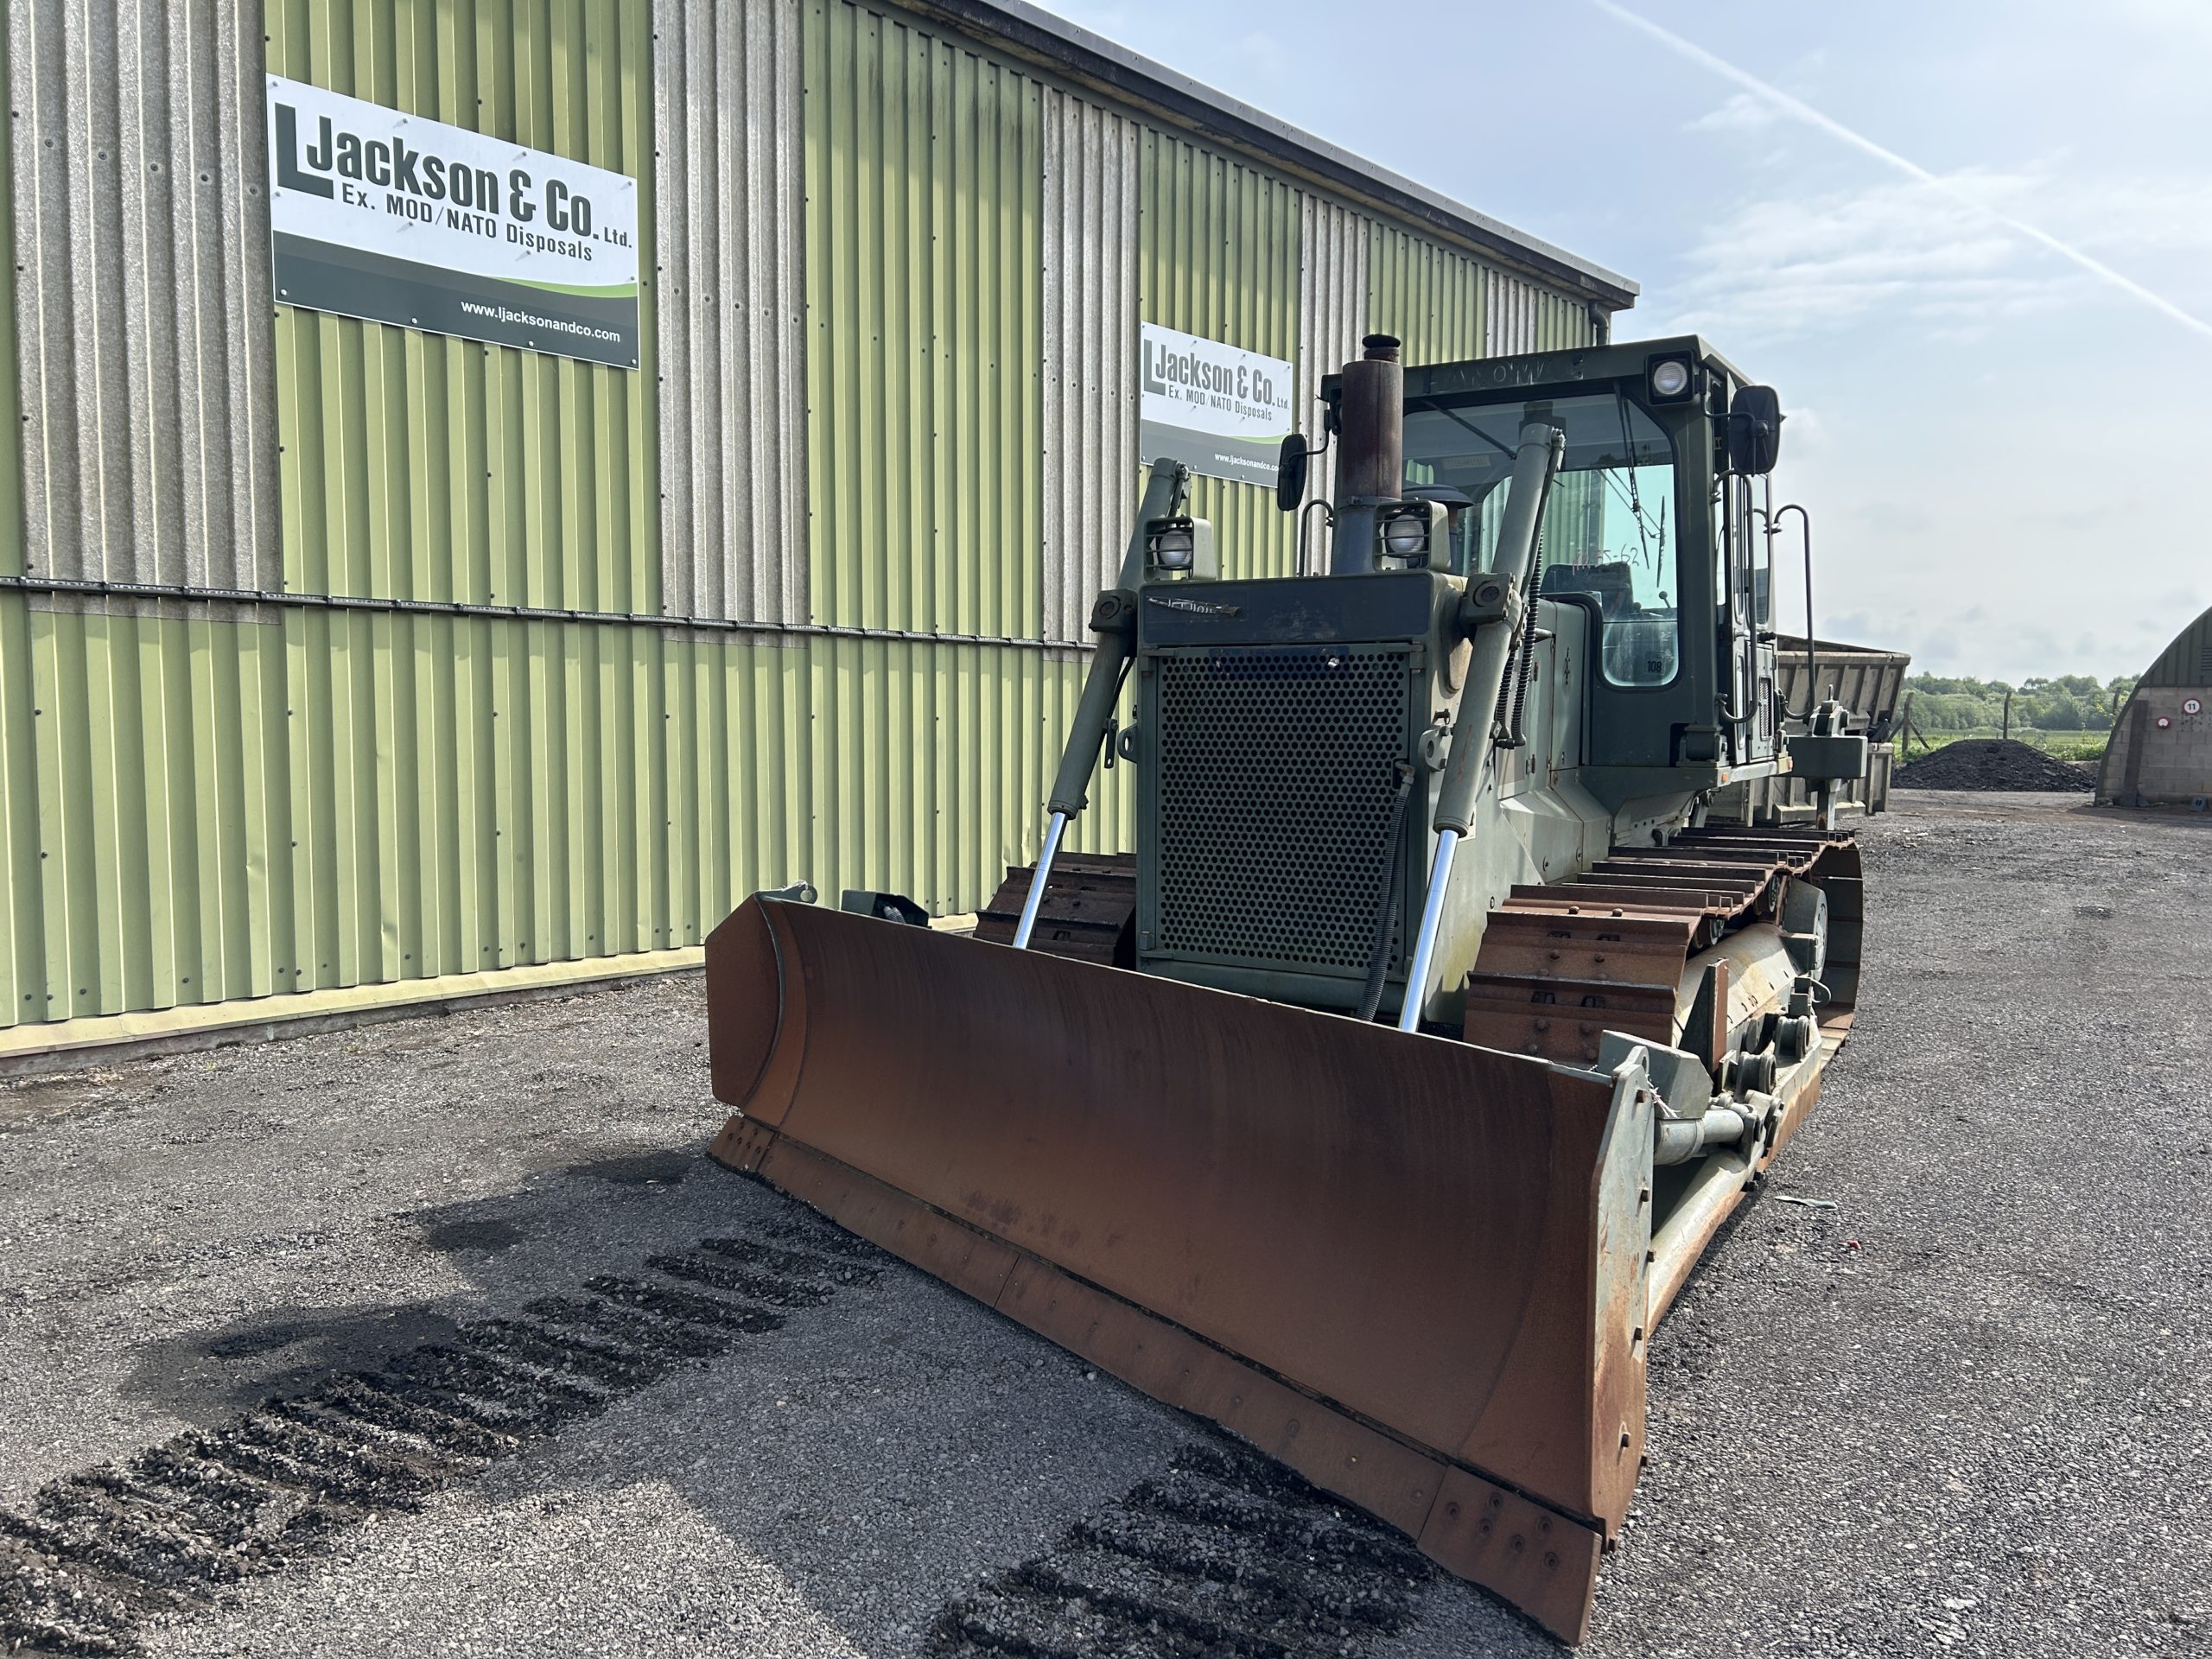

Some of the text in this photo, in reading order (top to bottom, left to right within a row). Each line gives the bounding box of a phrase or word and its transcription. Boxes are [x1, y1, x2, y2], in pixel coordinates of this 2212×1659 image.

[342, 182, 375, 209] Ex.
[507, 224, 593, 261] Disposals
[510, 169, 536, 222] &
[545, 179, 599, 240] Co.
[605, 226, 632, 249] Ltd.
[461, 301, 621, 343] www.ljacksonandco.com
[1168, 385, 1182, 401] Ex.
[1235, 400, 1272, 422] Disposals
[1237, 365, 1249, 399] &
[1253, 369, 1275, 406] Co.
[1214, 452, 1280, 472] www.ljacksonandco.co
[1647, 660, 1662, 672] 108
